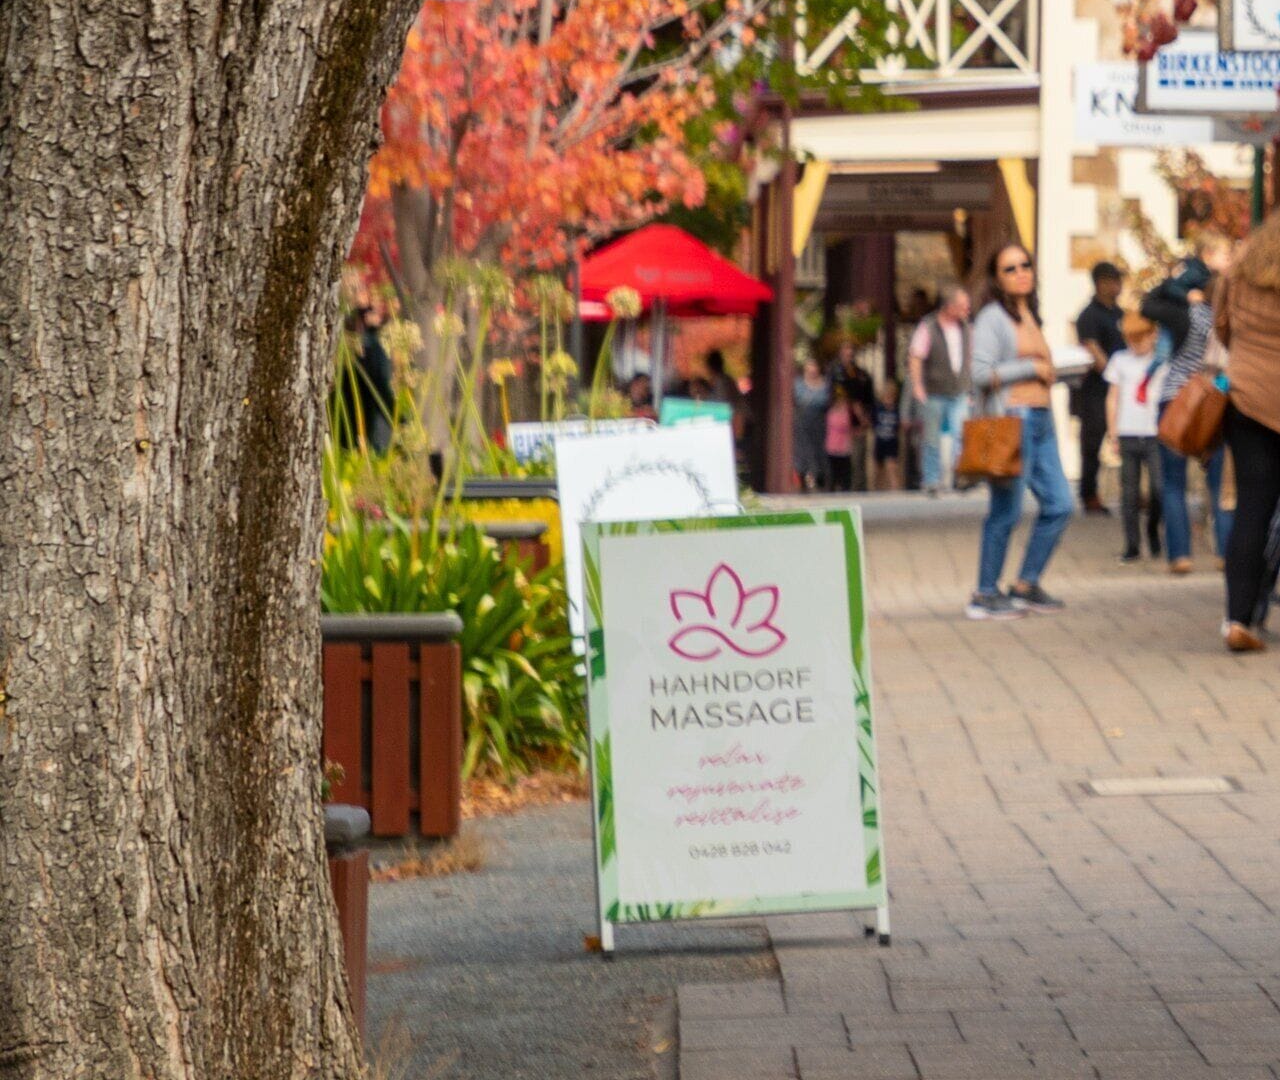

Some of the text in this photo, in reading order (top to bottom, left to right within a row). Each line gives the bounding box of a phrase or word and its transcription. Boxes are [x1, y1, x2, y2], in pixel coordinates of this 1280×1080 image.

[1090, 89, 1138, 117] KN
[649, 666, 813, 697] HAHNDORF
[650, 696, 816, 731] MASSAGE
